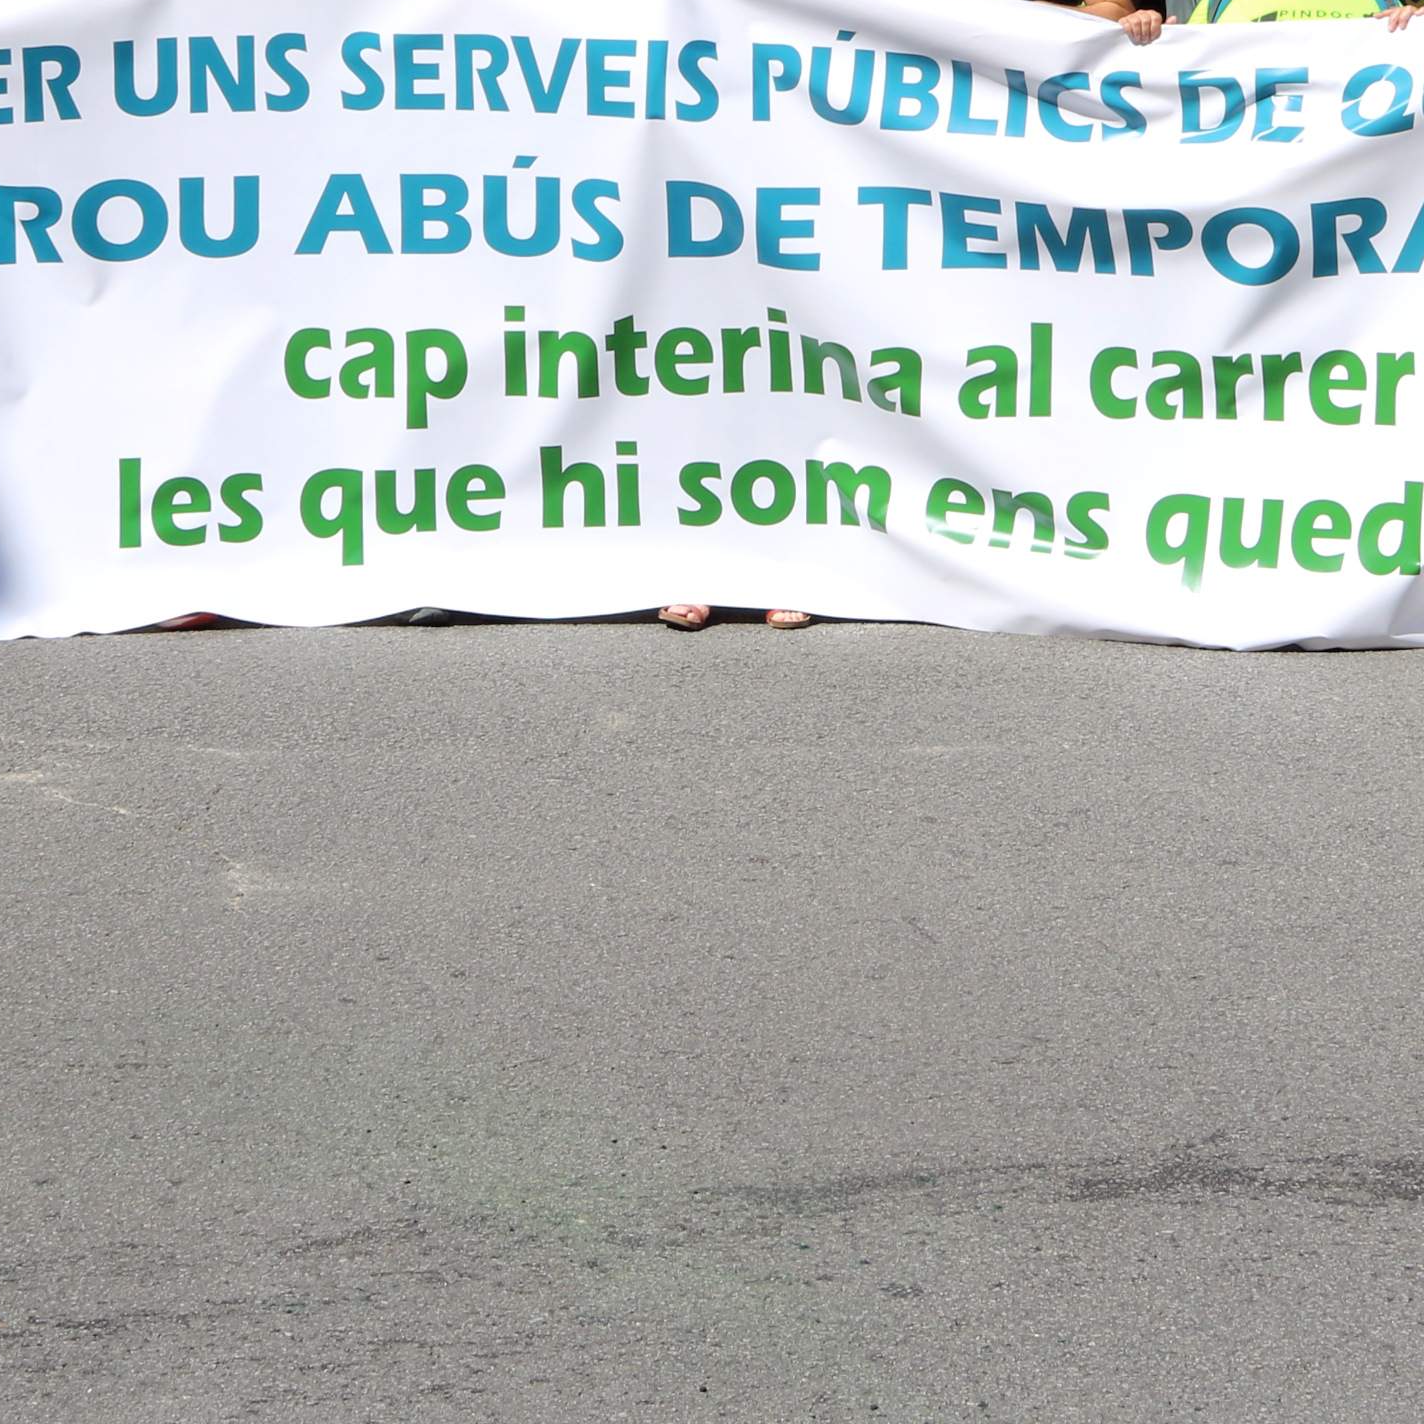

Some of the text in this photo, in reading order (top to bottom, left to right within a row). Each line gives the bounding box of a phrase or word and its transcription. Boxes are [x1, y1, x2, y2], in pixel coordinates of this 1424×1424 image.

[112, 32, 311, 118] UNS
[341, 30, 719, 123] SERVEIS
[751, 29, 1148, 144] PÚBLICS
[1177, 65, 1309, 145] DE
[294, 154, 625, 262] ABÚS
[666, 180, 822, 272] DE
[284, 326, 470, 431] cap
[503, 304, 924, 418] interina
[957, 321, 1054, 420] al
[1089, 344, 1416, 430] carrer
[117, 456, 264, 549] les
[299, 462, 506, 567] que
[538, 439, 640, 530] hi
[676, 458, 890, 534] som
[925, 476, 1112, 560] ens
